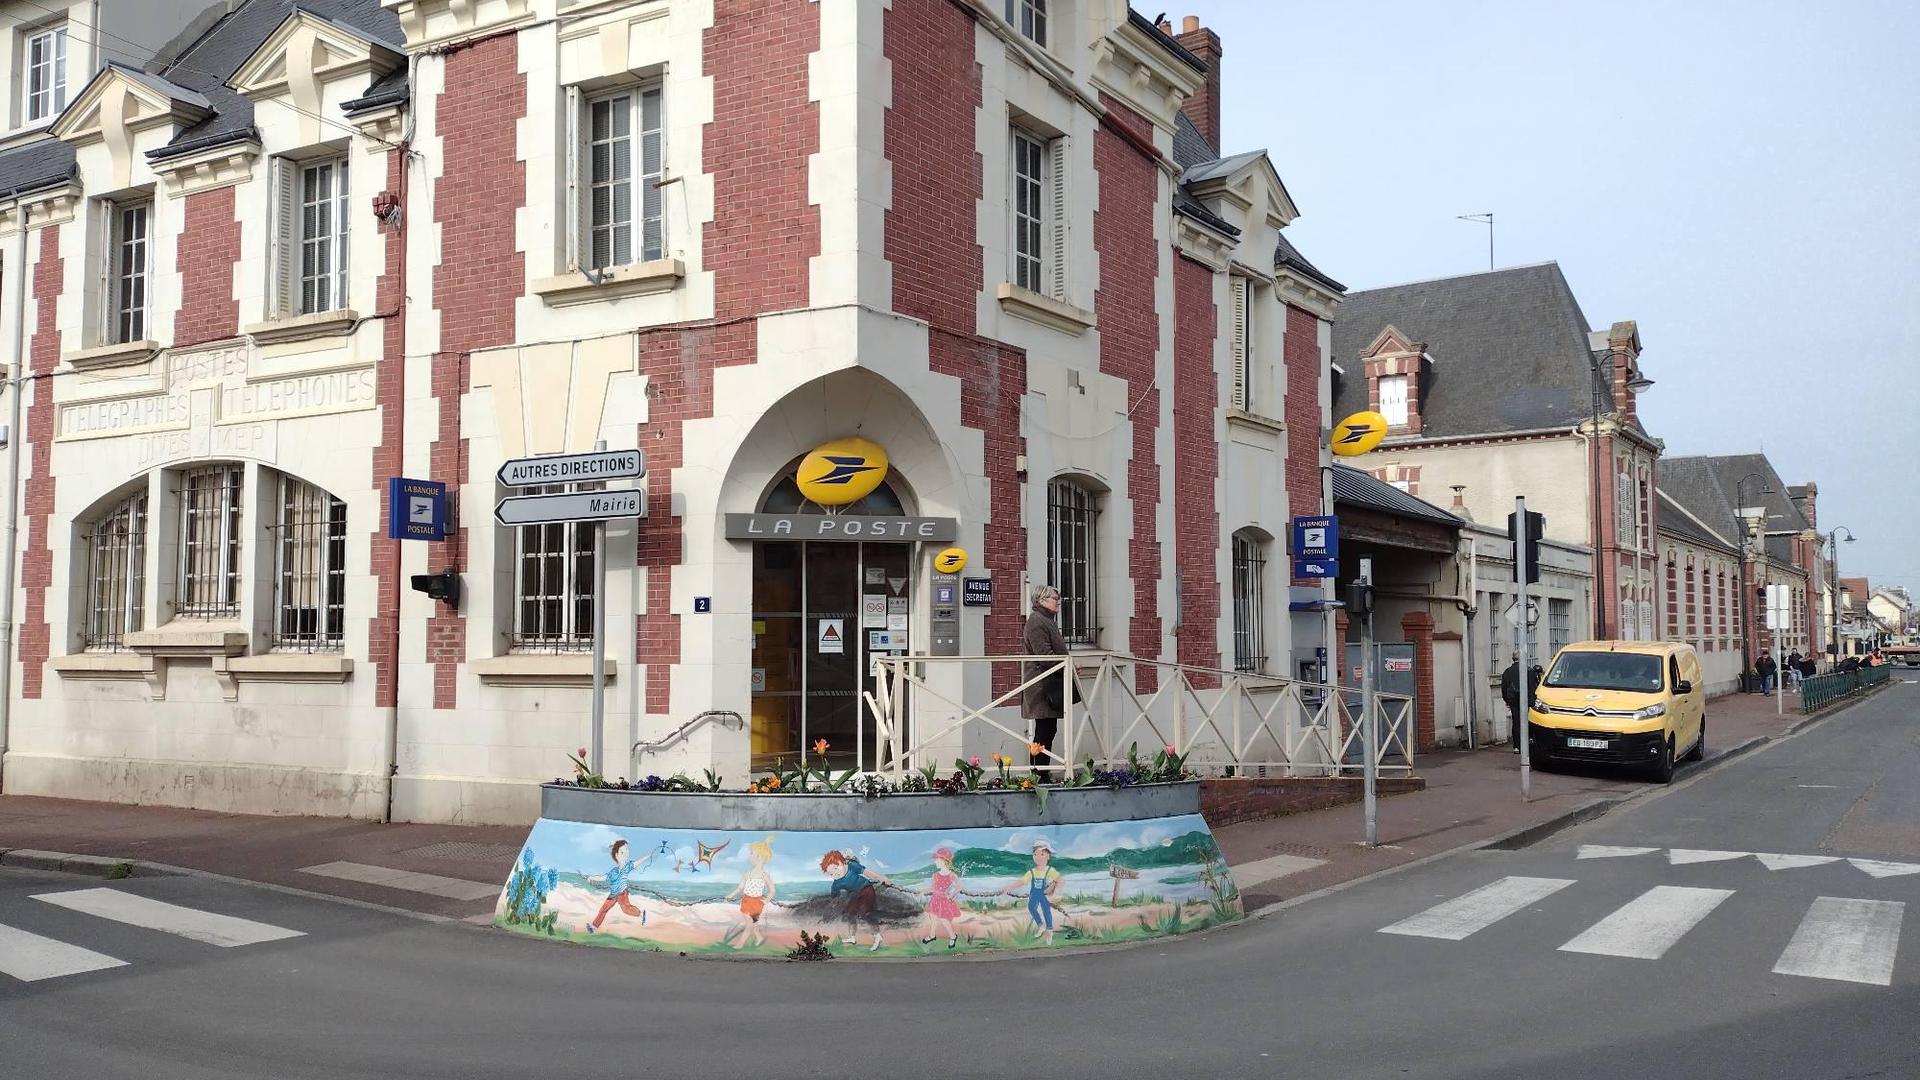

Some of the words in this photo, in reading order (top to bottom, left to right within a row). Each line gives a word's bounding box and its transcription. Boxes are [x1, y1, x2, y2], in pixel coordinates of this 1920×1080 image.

[170, 348, 246, 388] POSTES
[223, 370, 377, 416] TELEPHONES
[63, 394, 188, 433] TELEGRAPHES
[512, 464, 558, 479] AUTRES
[561, 457, 635, 476] DIRECTIONS
[404, 485, 413, 493] LA
[413, 486, 439, 496] BANQUE
[590, 496, 636, 513] Mairie
[407, 525, 435, 534] POSTALE
[748, 519, 793, 533] LA
[818, 520, 936, 536] POSTE
[969, 581, 990, 591] AVENUE
[699, 599, 705, 610] 2
